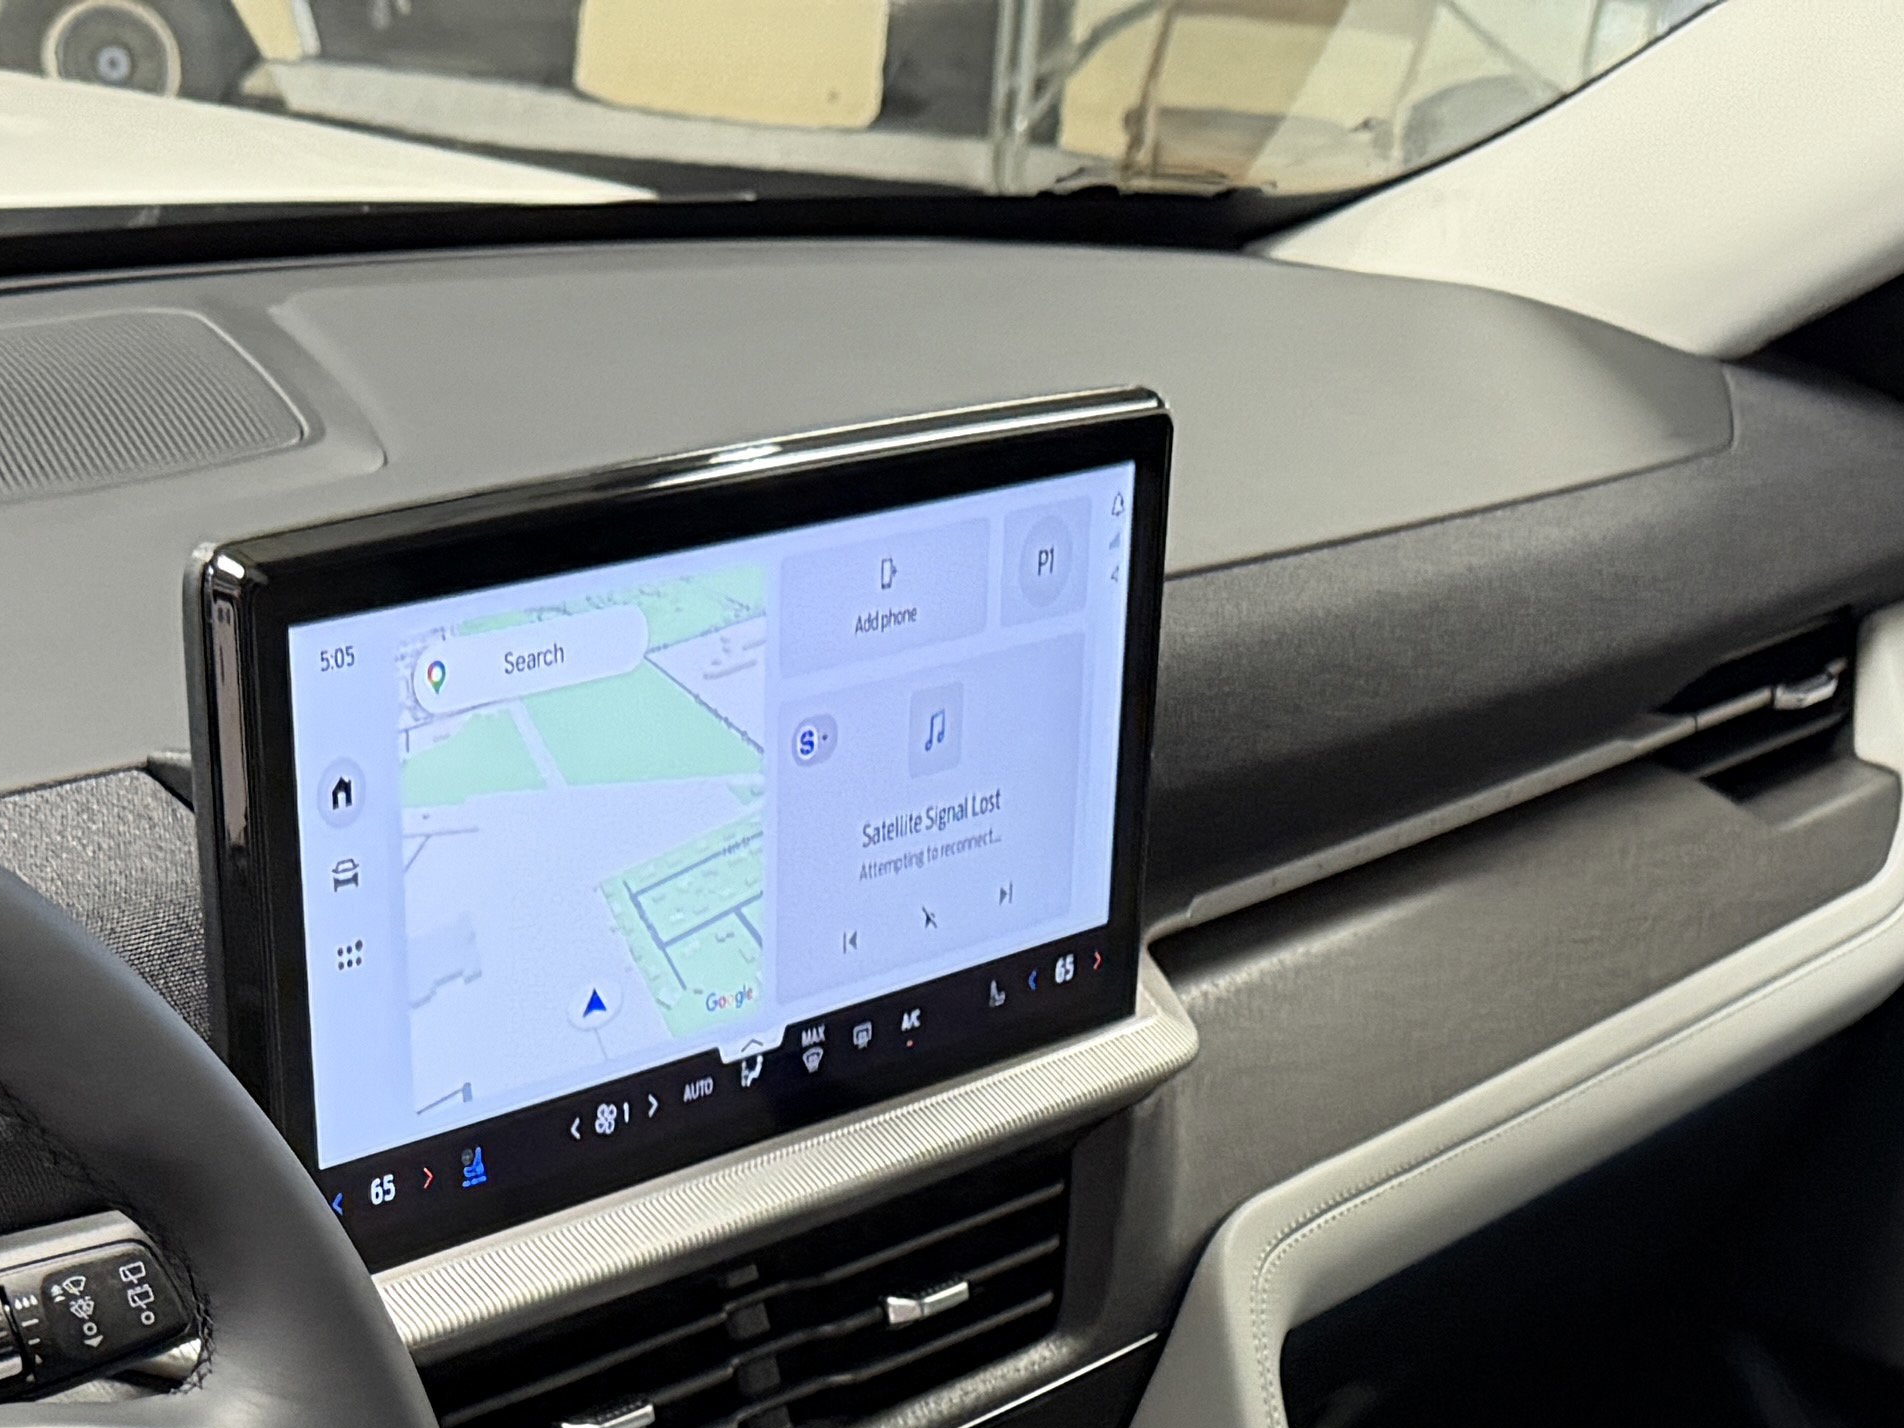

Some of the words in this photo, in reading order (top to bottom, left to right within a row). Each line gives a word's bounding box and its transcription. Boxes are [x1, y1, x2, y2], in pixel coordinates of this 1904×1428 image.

[1037, 545, 1055, 576] P1
[855, 613, 879, 634] Add
[880, 606, 918, 631] phone
[320, 645, 355, 672] 5:05
[504, 642, 565, 675] Search
[862, 811, 923, 848] Satellite
[925, 796, 969, 832] Signal
[972, 788, 1001, 818] Lost
[860, 845, 925, 881] Attempting
[927, 841, 939, 859] to
[1055, 954, 1075, 984] 65
[706, 984, 753, 1011] Google
[901, 1009, 921, 1031] A/C
[801, 1024, 826, 1047] MAX
[684, 1078, 713, 1102] AUTO
[371, 1174, 396, 1206] 65
